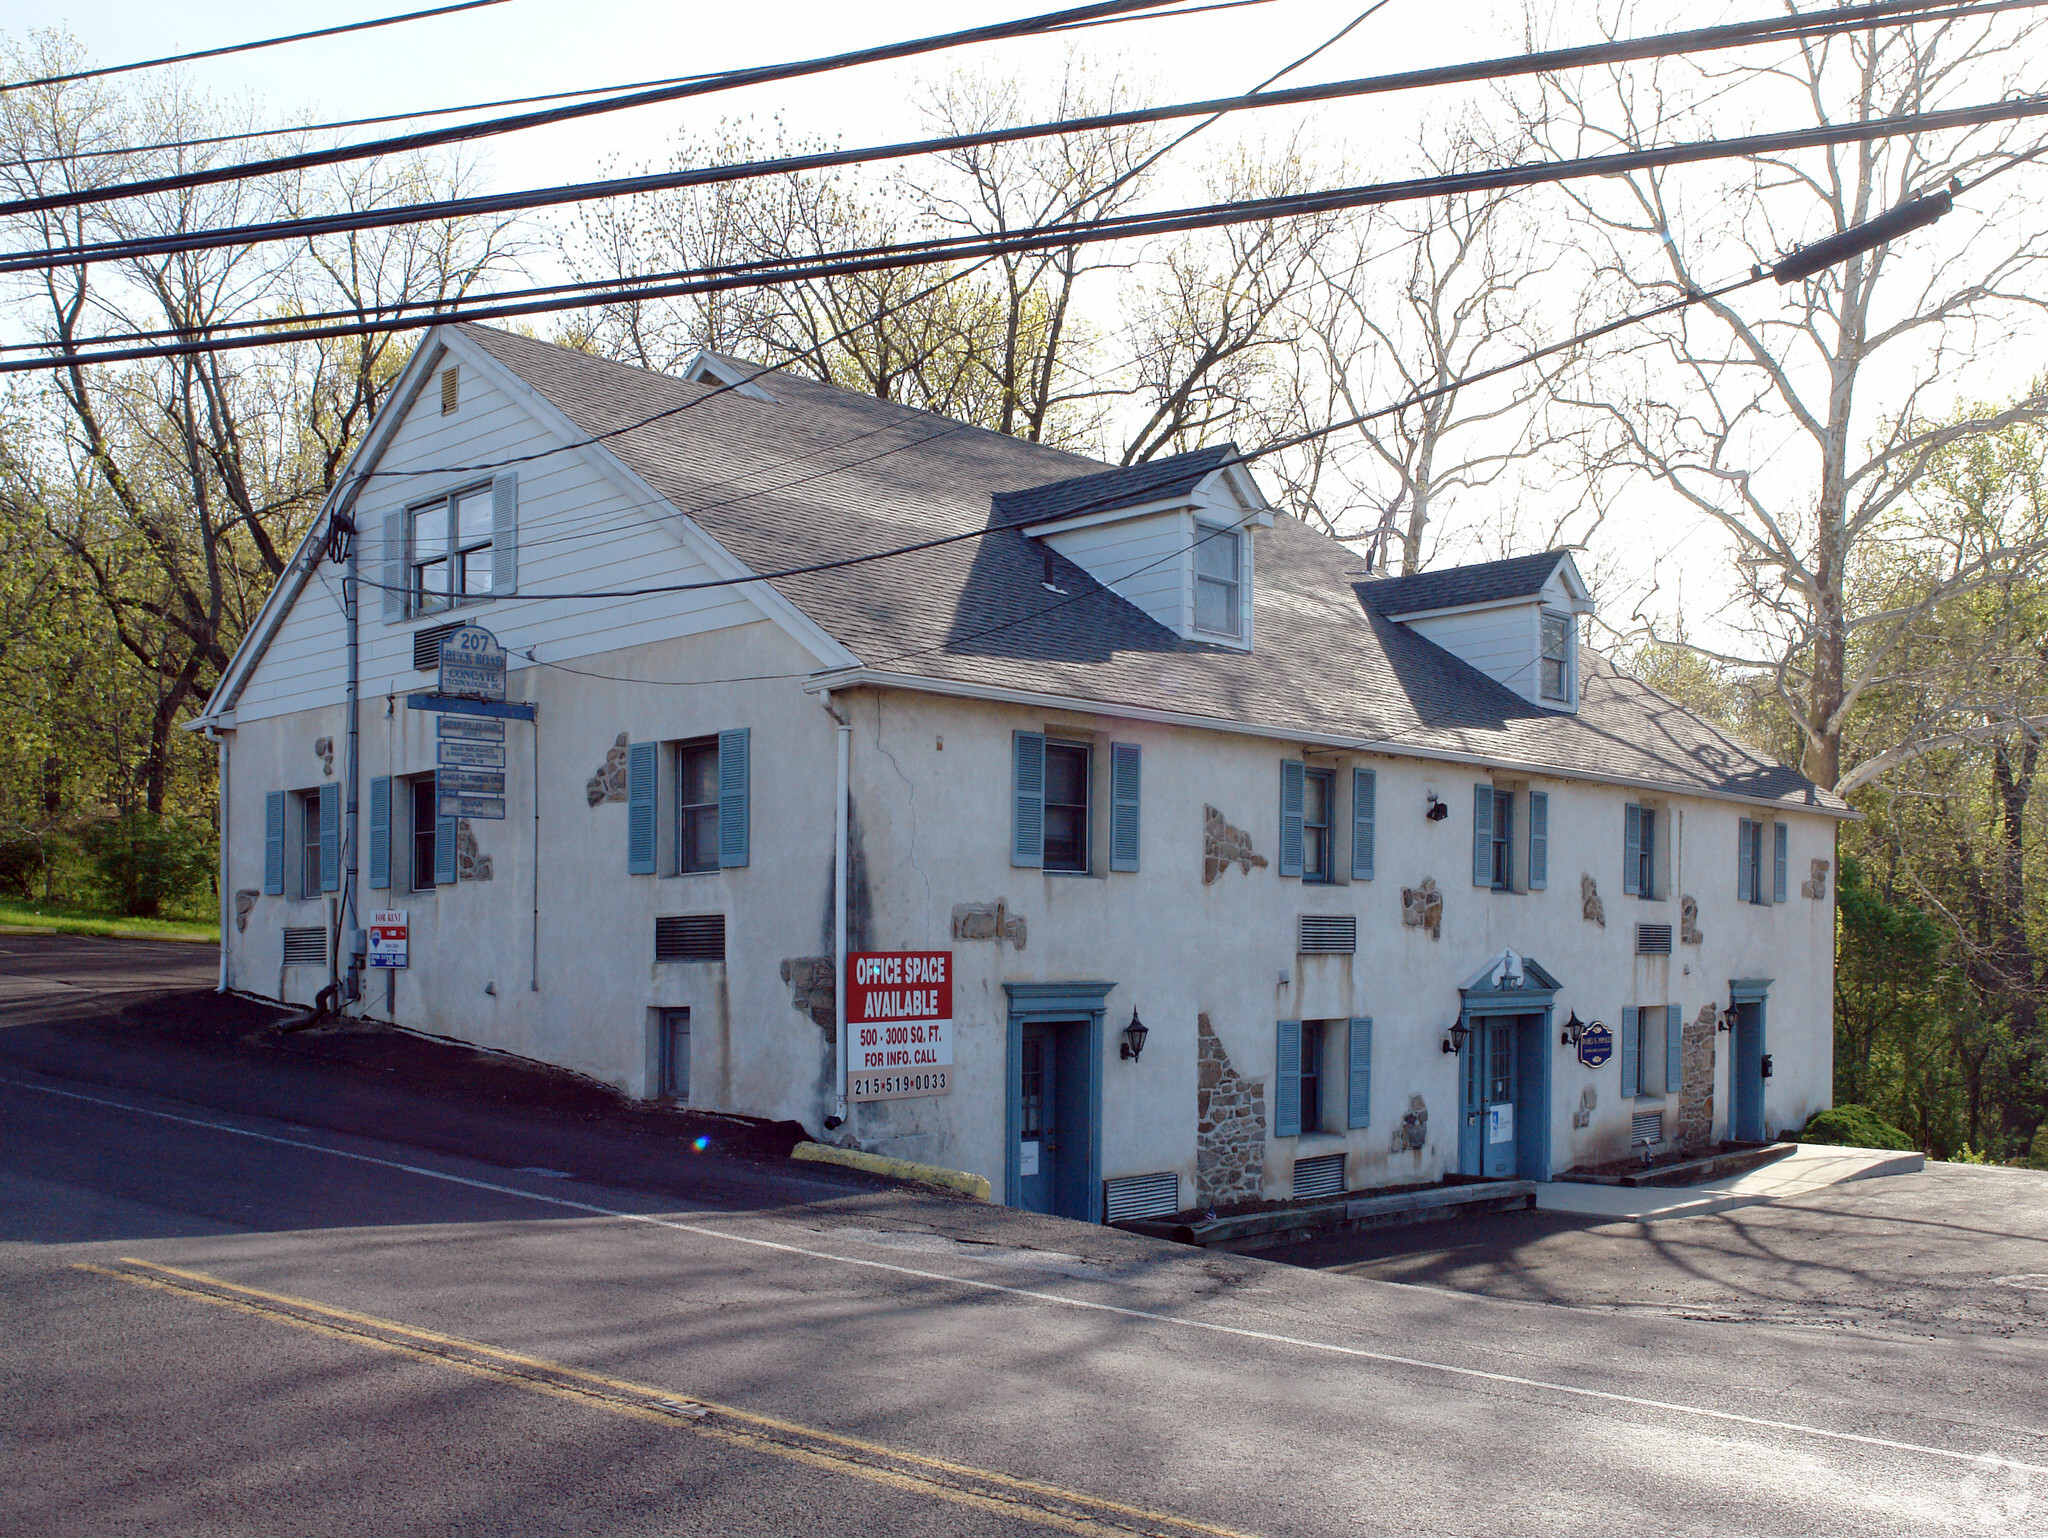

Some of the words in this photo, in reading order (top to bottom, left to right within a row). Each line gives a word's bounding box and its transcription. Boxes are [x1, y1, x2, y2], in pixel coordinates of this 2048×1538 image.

[461, 632, 489, 652] 207
[444, 649, 473, 664] BUCK
[475, 652, 503, 668] ROAD
[376, 913, 386, 922] FOR
[387, 913, 401, 922] RENT
[856, 957, 902, 985] OFFICE
[904, 956, 946, 984] SPACE
[864, 989, 939, 1018] AVAILABLE
[860, 1028, 878, 1046] 500
[885, 1026, 908, 1045] 3000
[910, 1025, 926, 1044] SQ.
[928, 1025, 942, 1042] FT.
[864, 1052, 884, 1067] FOR
[886, 1050, 912, 1066] INFO.
[914, 1049, 937, 1064] CALL
